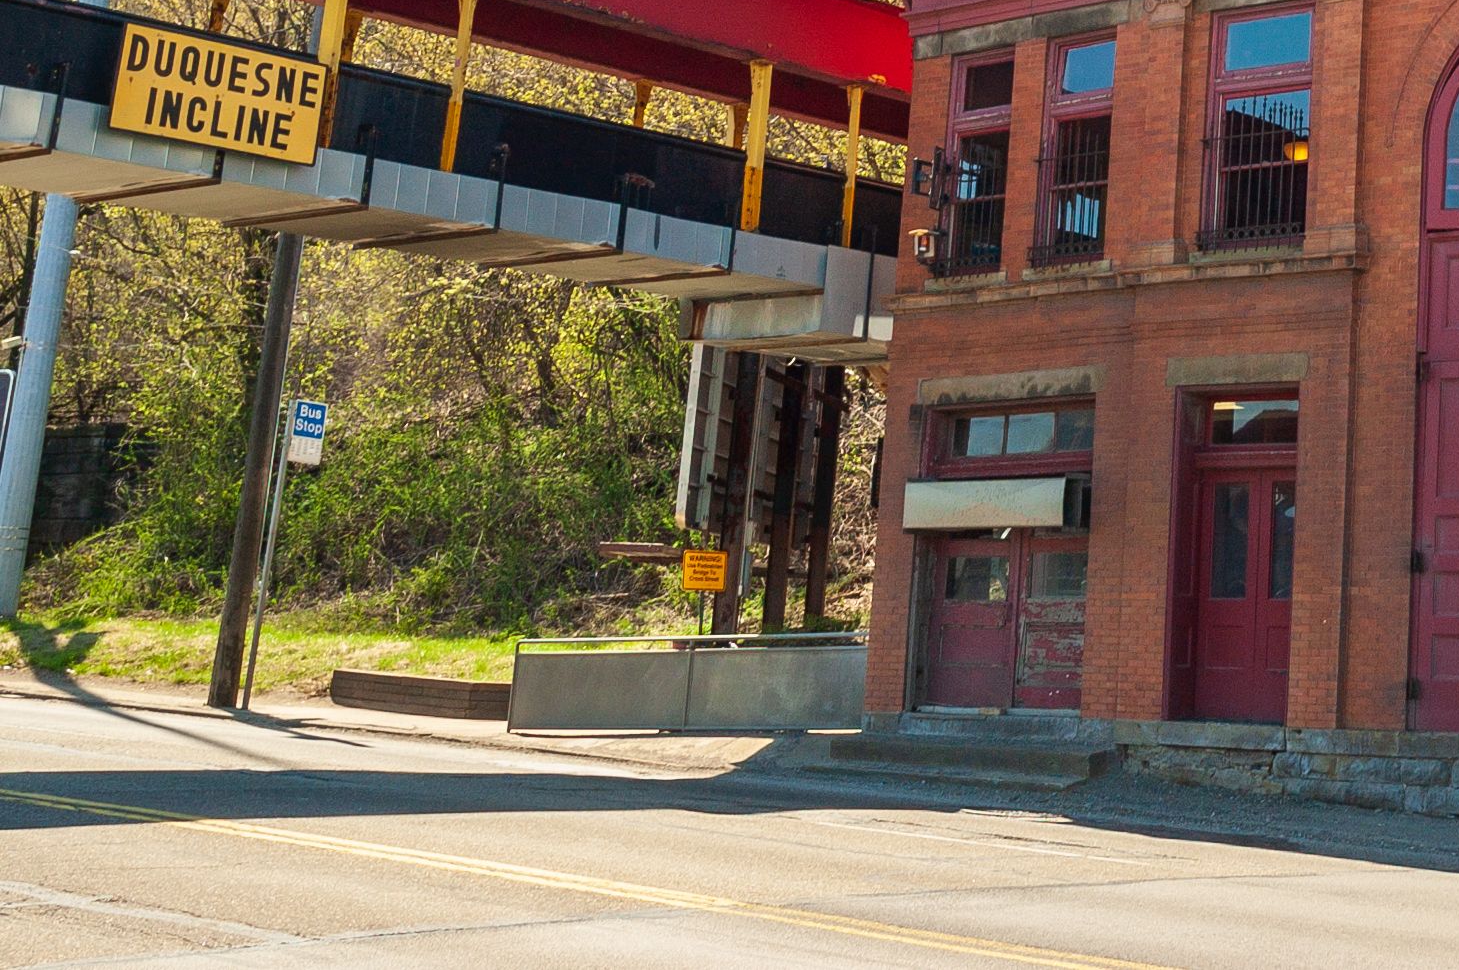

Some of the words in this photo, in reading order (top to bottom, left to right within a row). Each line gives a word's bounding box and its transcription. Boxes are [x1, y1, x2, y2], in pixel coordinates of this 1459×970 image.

[126, 33, 320, 109] DUQUESNE
[144, 86, 293, 150] INCLINE
[295, 418, 323, 436] Stop
[300, 404, 322, 420] Bus
